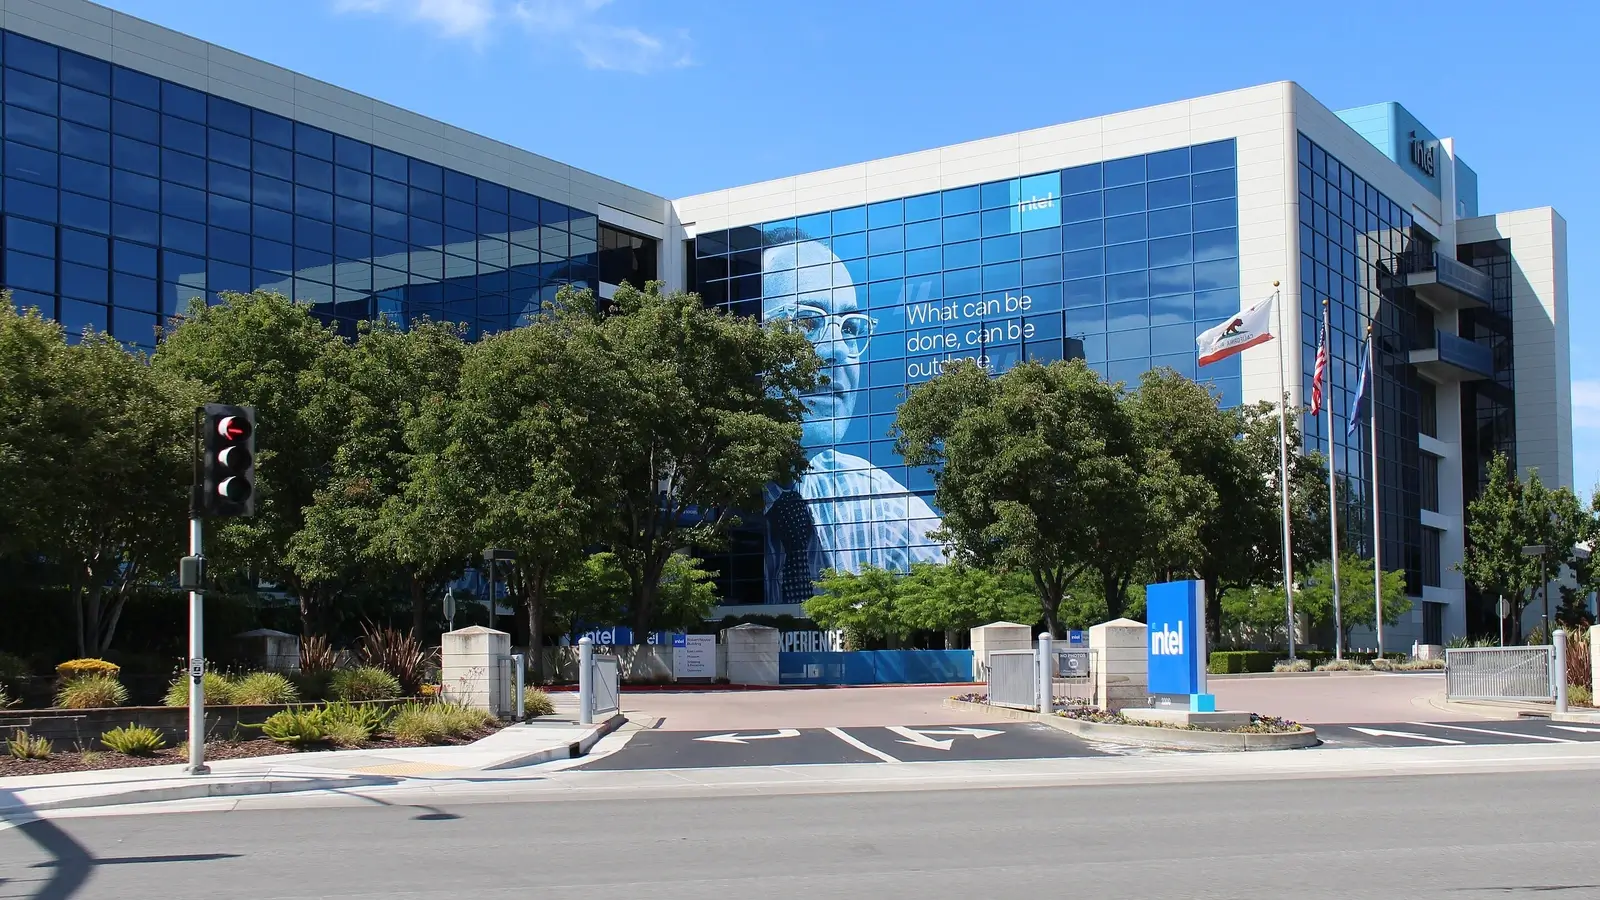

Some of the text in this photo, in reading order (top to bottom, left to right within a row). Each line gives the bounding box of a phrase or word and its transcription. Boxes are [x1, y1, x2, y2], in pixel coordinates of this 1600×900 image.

[1409, 130, 1434, 177] intel
[1017, 192, 1053, 212] intel
[907, 292, 1032, 325] What can be
[907, 320, 1035, 352] done, can be
[1151, 620, 1184, 655] intel
